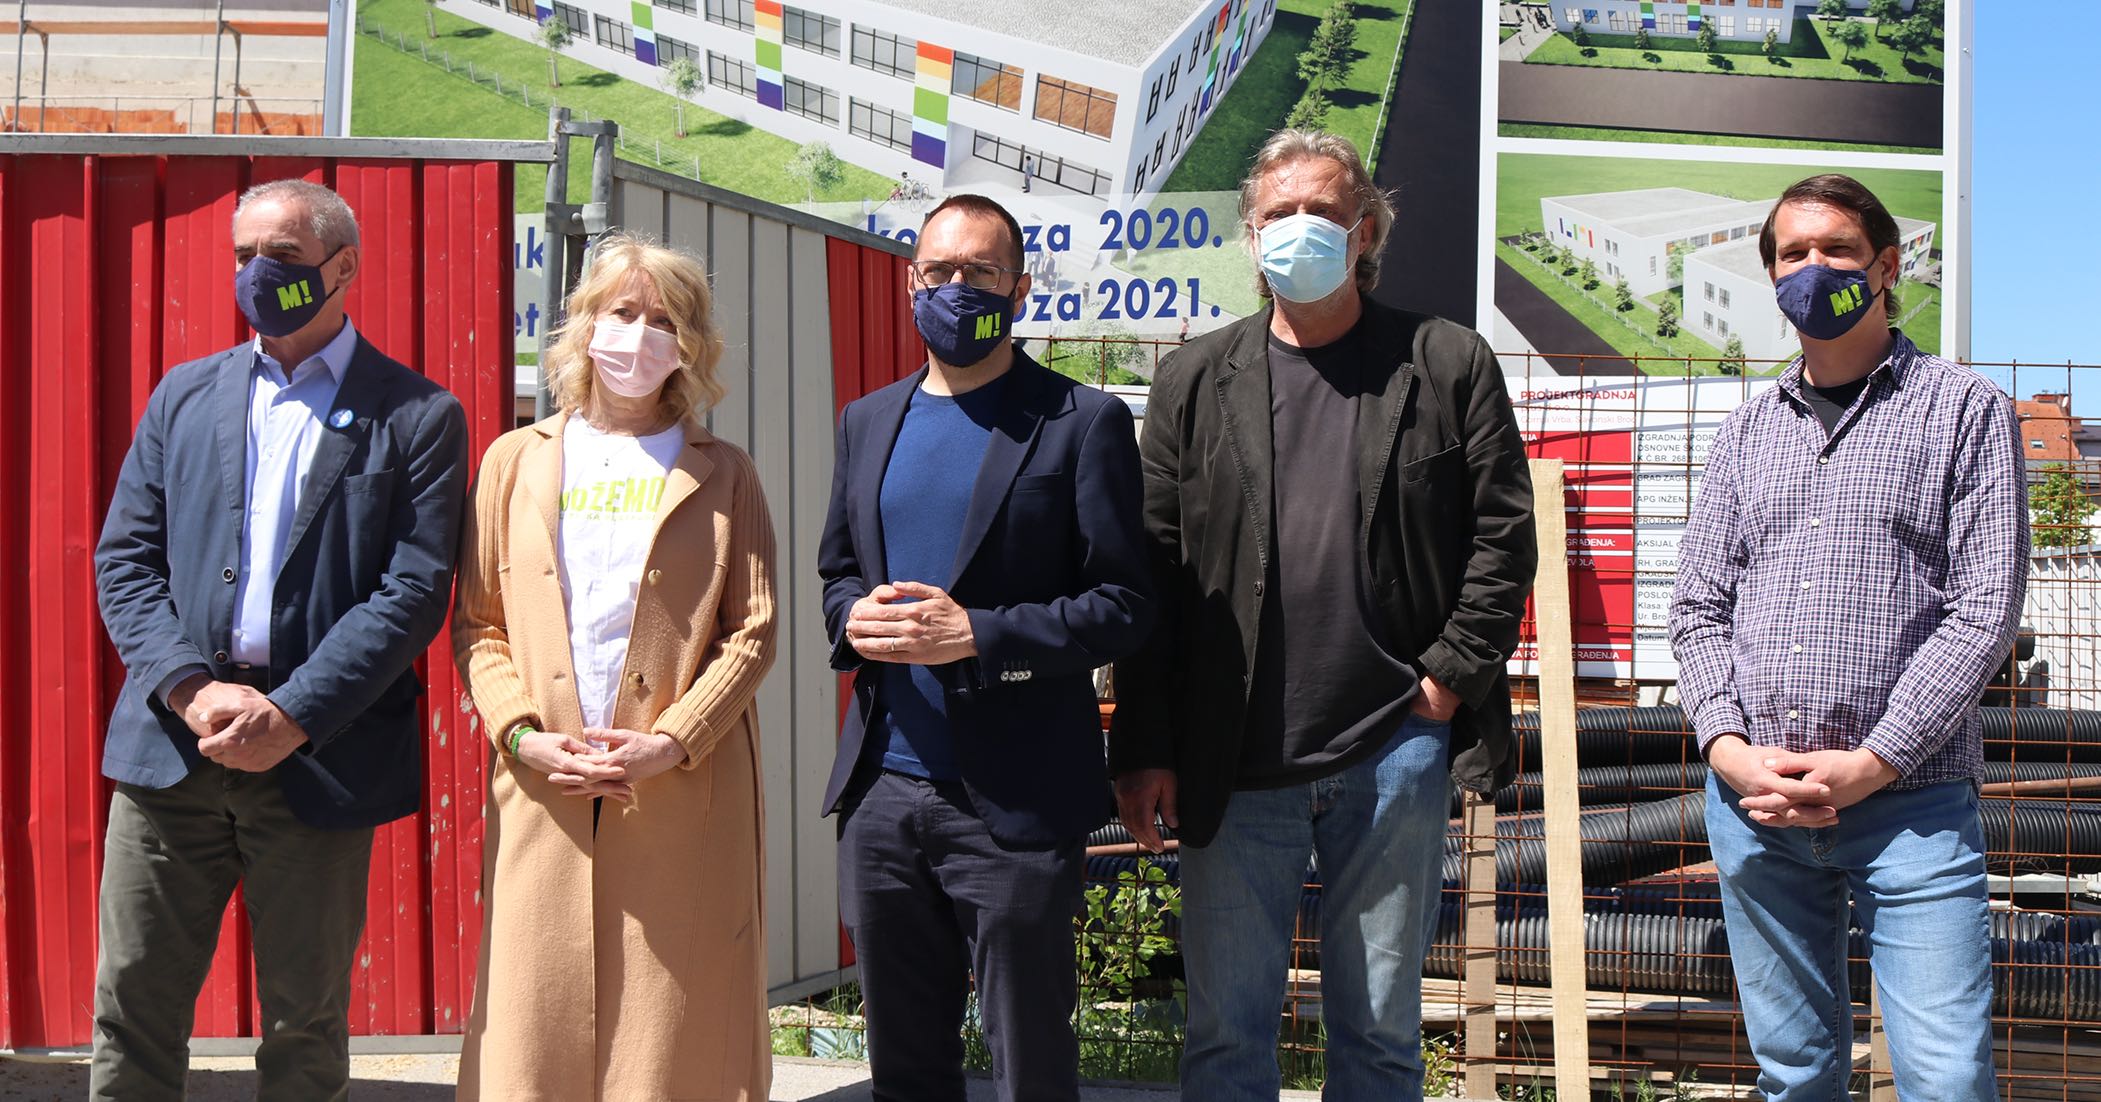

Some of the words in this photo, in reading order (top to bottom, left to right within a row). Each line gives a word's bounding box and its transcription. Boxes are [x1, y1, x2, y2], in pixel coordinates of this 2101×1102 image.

[1100, 207, 1223, 250] 2020.
[277, 280, 313, 311] M!
[1097, 278, 1221, 320] 2021.
[1830, 283, 1863, 317] M!
[975, 312, 1001, 340] M!
[1520, 390, 1635, 400] PROJEKTGRADNJA
[1637, 444, 1680, 452] OSNOVNE
[1636, 474, 1661, 482] GRAD
[1663, 474, 1699, 482] ZAGREB
[1636, 495, 1656, 503] APG
